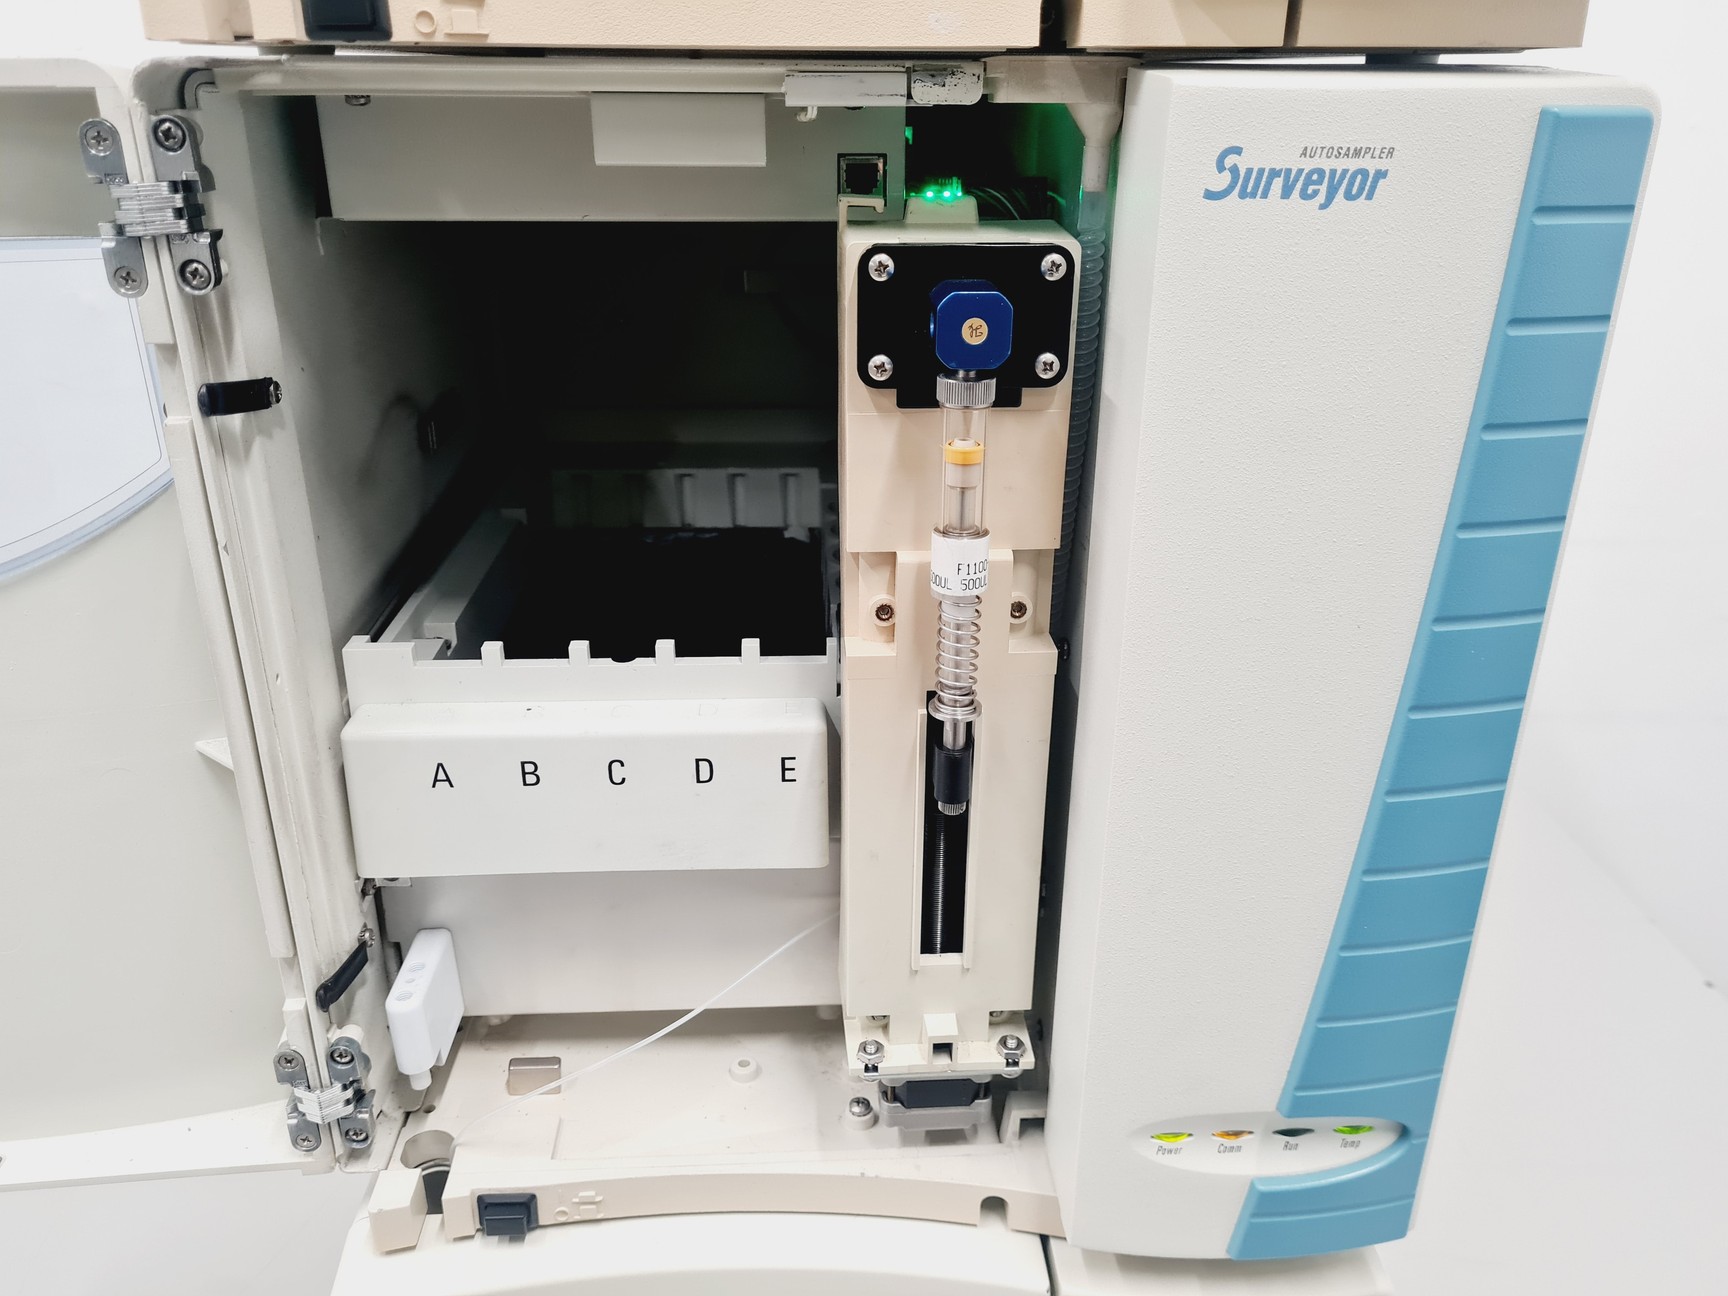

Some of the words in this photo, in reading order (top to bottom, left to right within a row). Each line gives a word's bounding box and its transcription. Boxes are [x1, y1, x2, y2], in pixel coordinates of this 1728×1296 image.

[1300, 146, 1395, 159] AUTOSAMPLER
[1202, 145, 1389, 210] Surveyor
[931, 570, 952, 591] 00UL
[431, 762, 454, 788] A
[520, 760, 541, 787] B
[607, 759, 627, 786] C
[694, 758, 714, 784] D
[780, 756, 797, 783] E
[1156, 1145, 1183, 1156] Power
[1217, 1143, 1242, 1154] Comm
[1282, 1140, 1299, 1151] Run
[1340, 1138, 1361, 1149] Temp
